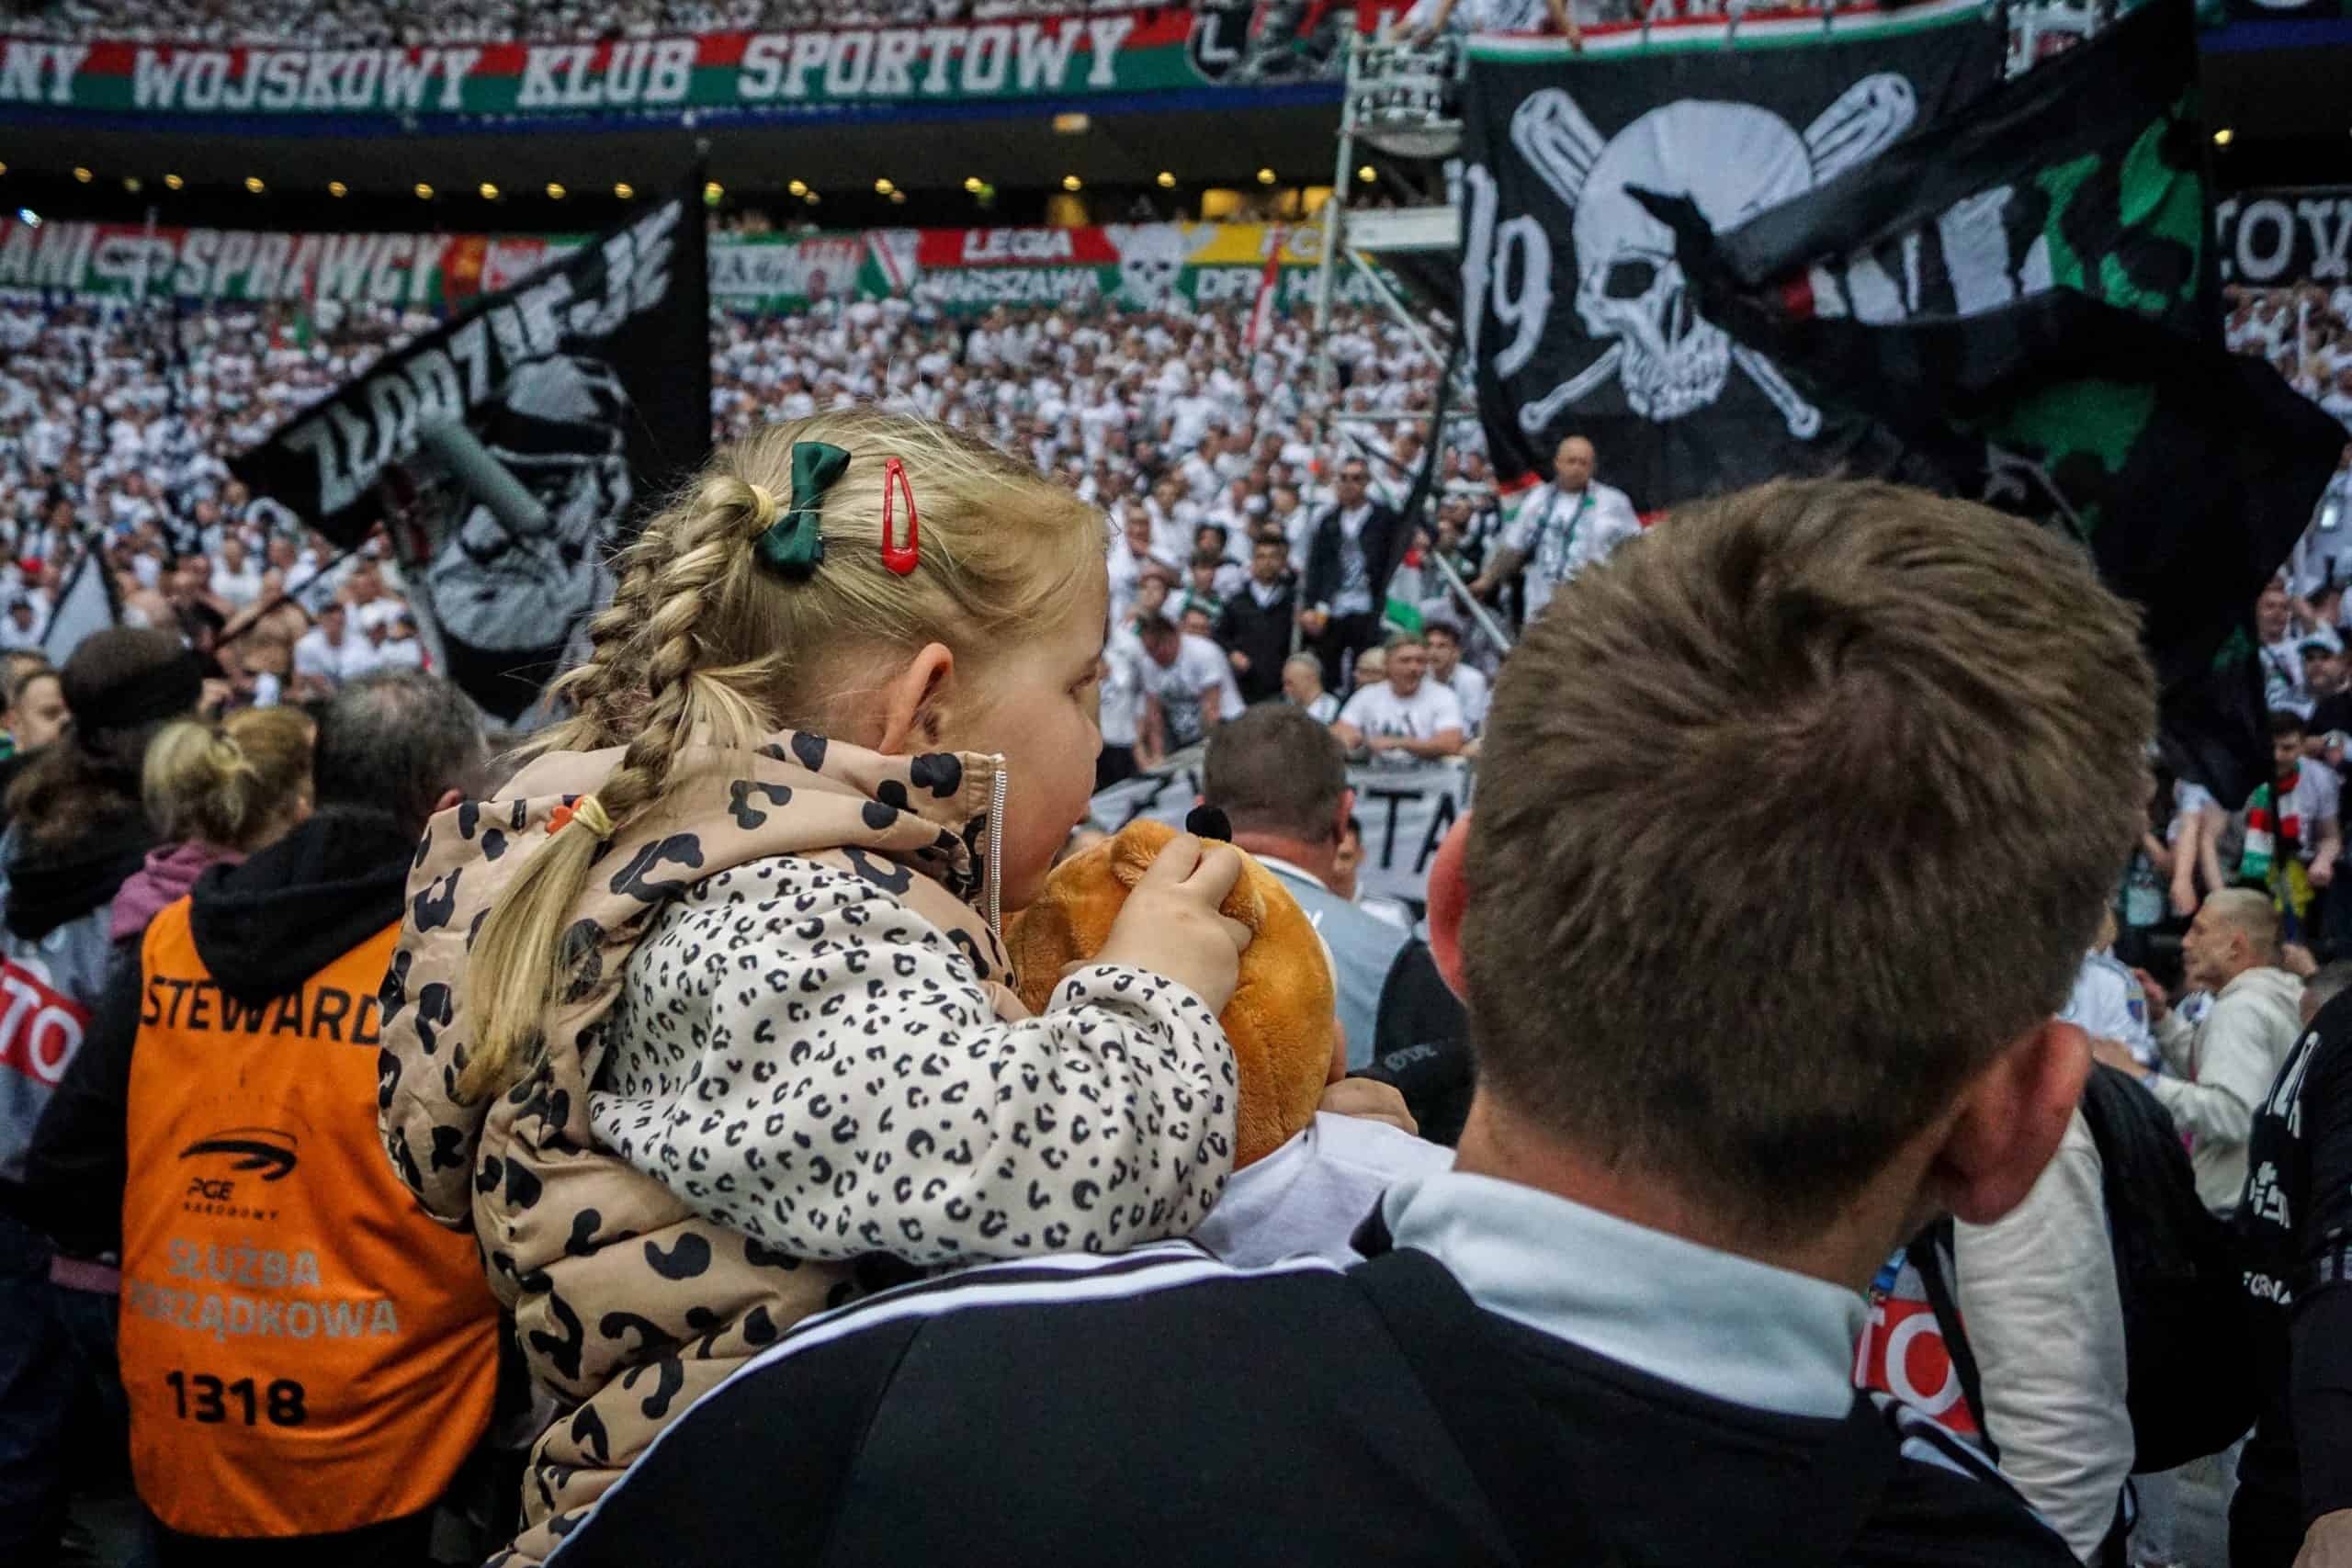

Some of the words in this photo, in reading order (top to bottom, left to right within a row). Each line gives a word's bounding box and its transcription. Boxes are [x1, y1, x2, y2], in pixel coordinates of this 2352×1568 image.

[133, 50, 481, 109] WOJSKOWY
[517, 39, 697, 107] KLUB
[737, 17, 1135, 99] SPORTOWY
[963, 228, 1072, 259] LEGIA
[141, 974, 380, 1046] STEWARD
[187, 1177, 235, 1201] PGE
[168, 1237, 322, 1289] SŁUŻBA
[166, 1371, 306, 1426] 1318
